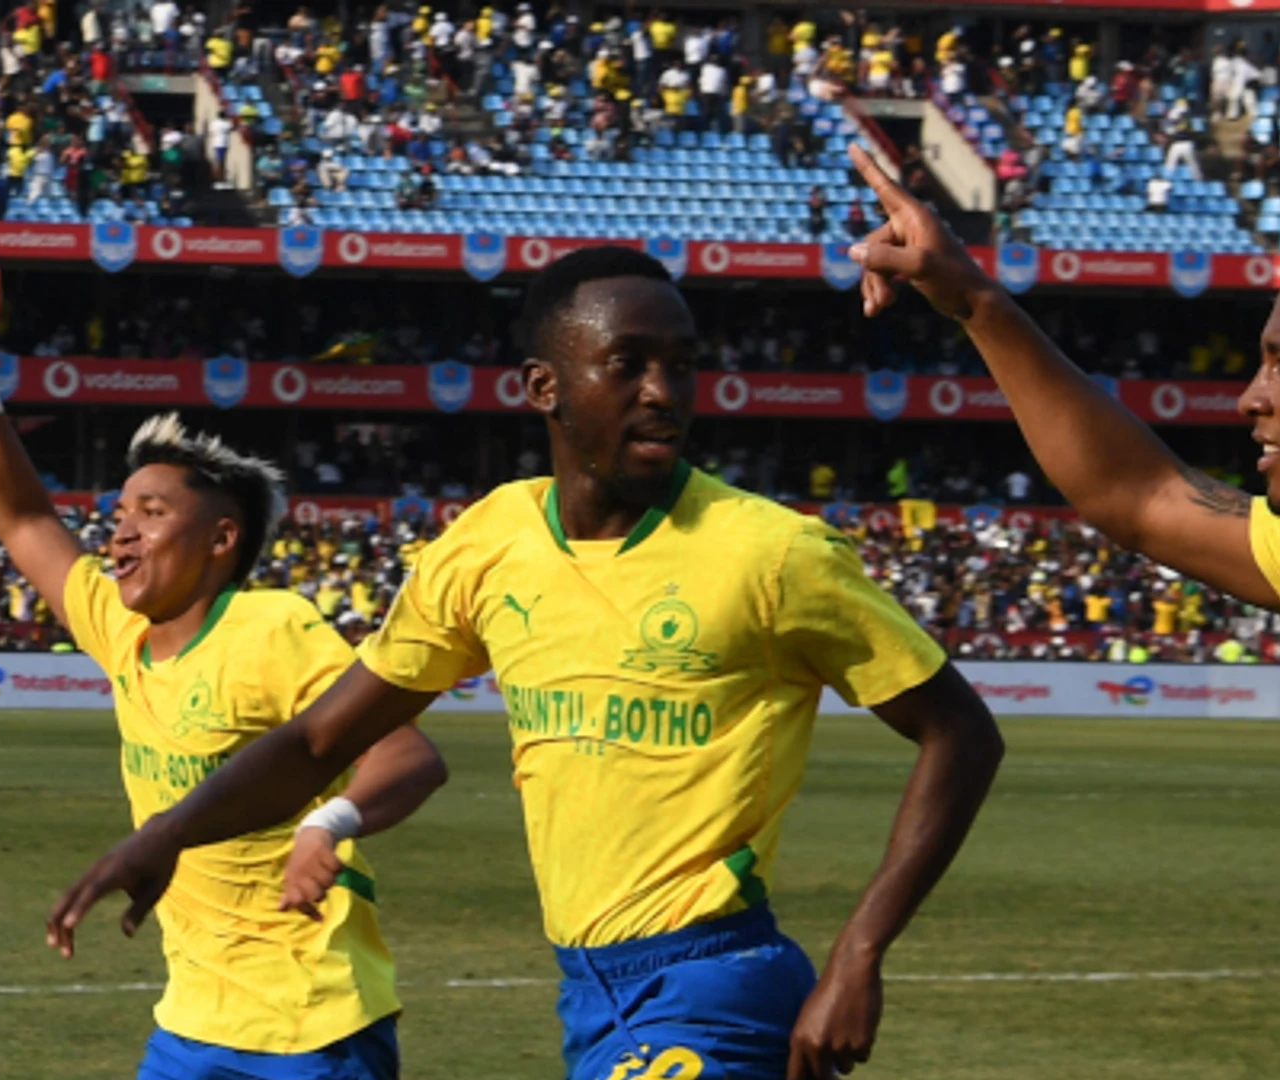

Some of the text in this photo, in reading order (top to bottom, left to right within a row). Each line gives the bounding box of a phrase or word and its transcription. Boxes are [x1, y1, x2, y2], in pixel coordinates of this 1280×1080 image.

[83, 370, 178, 390] vodacom
[312, 375, 404, 395] vodacom
[604, 694, 713, 747] BOTHO
